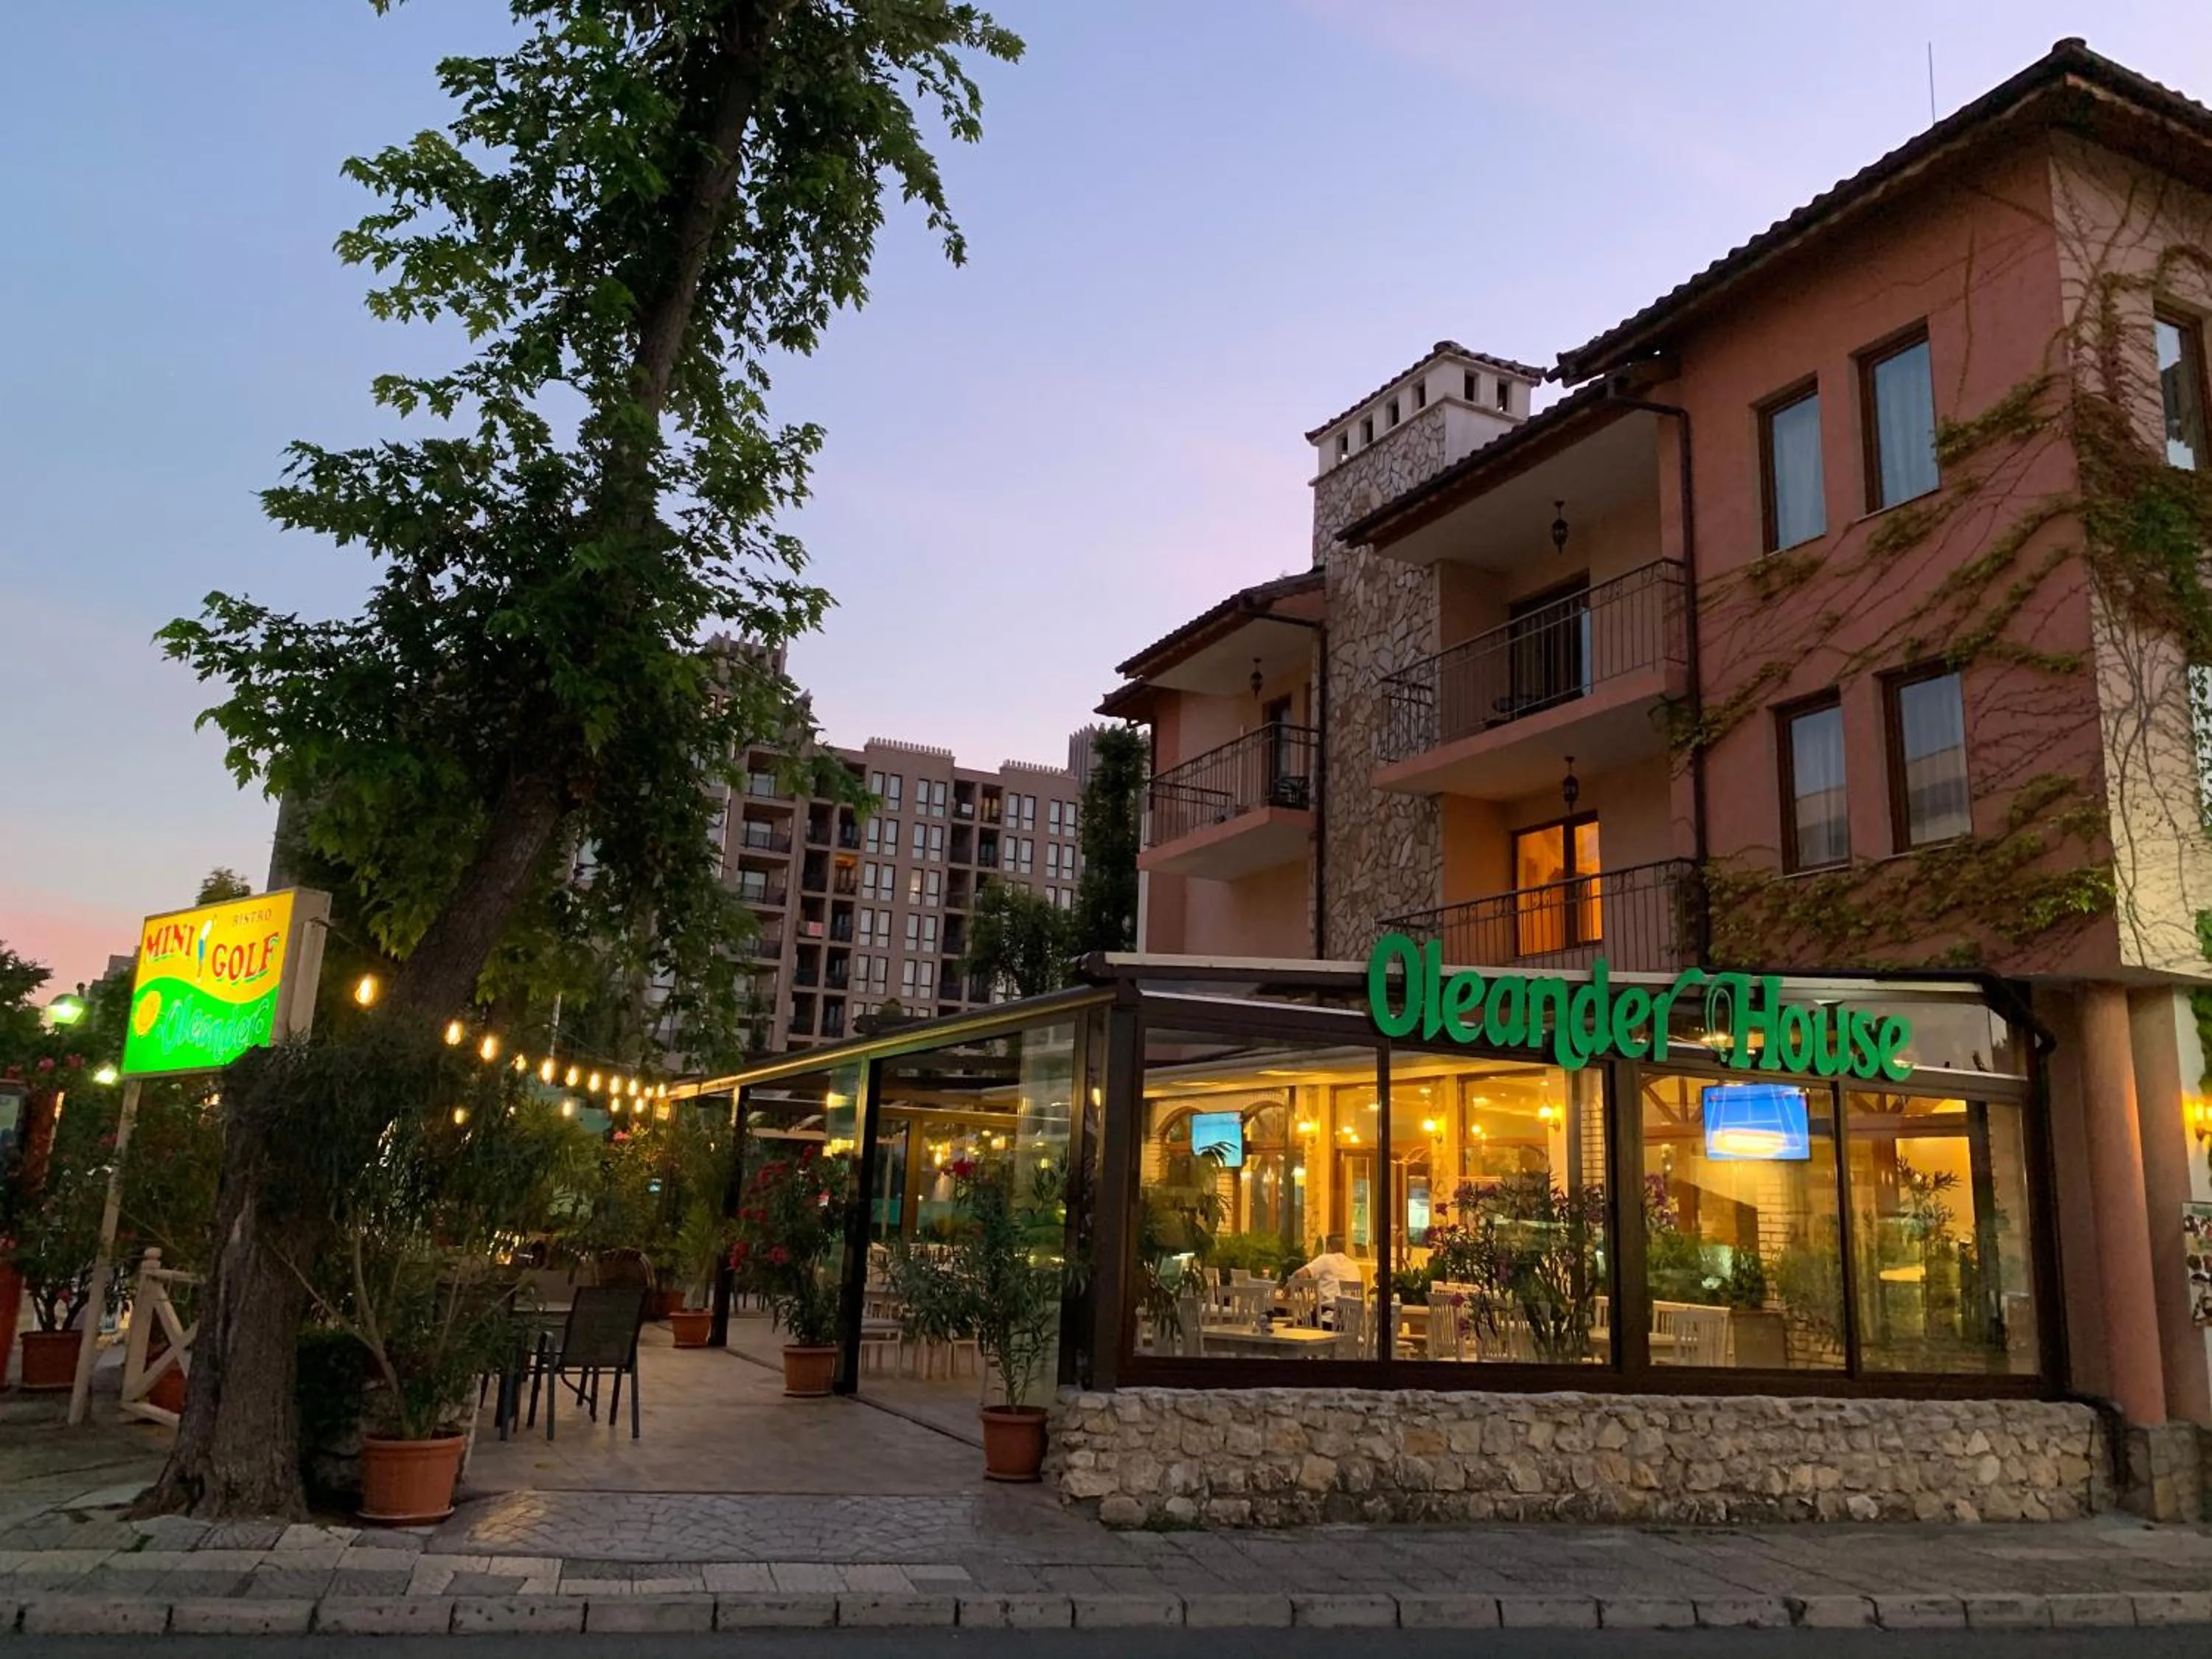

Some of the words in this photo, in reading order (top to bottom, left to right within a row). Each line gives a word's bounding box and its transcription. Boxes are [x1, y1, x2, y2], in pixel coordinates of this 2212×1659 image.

[146, 924, 195, 958] MINI
[212, 932, 279, 982] GOLF
[1368, 933, 1705, 1070] Oleander
[1705, 972, 1913, 1081] House
